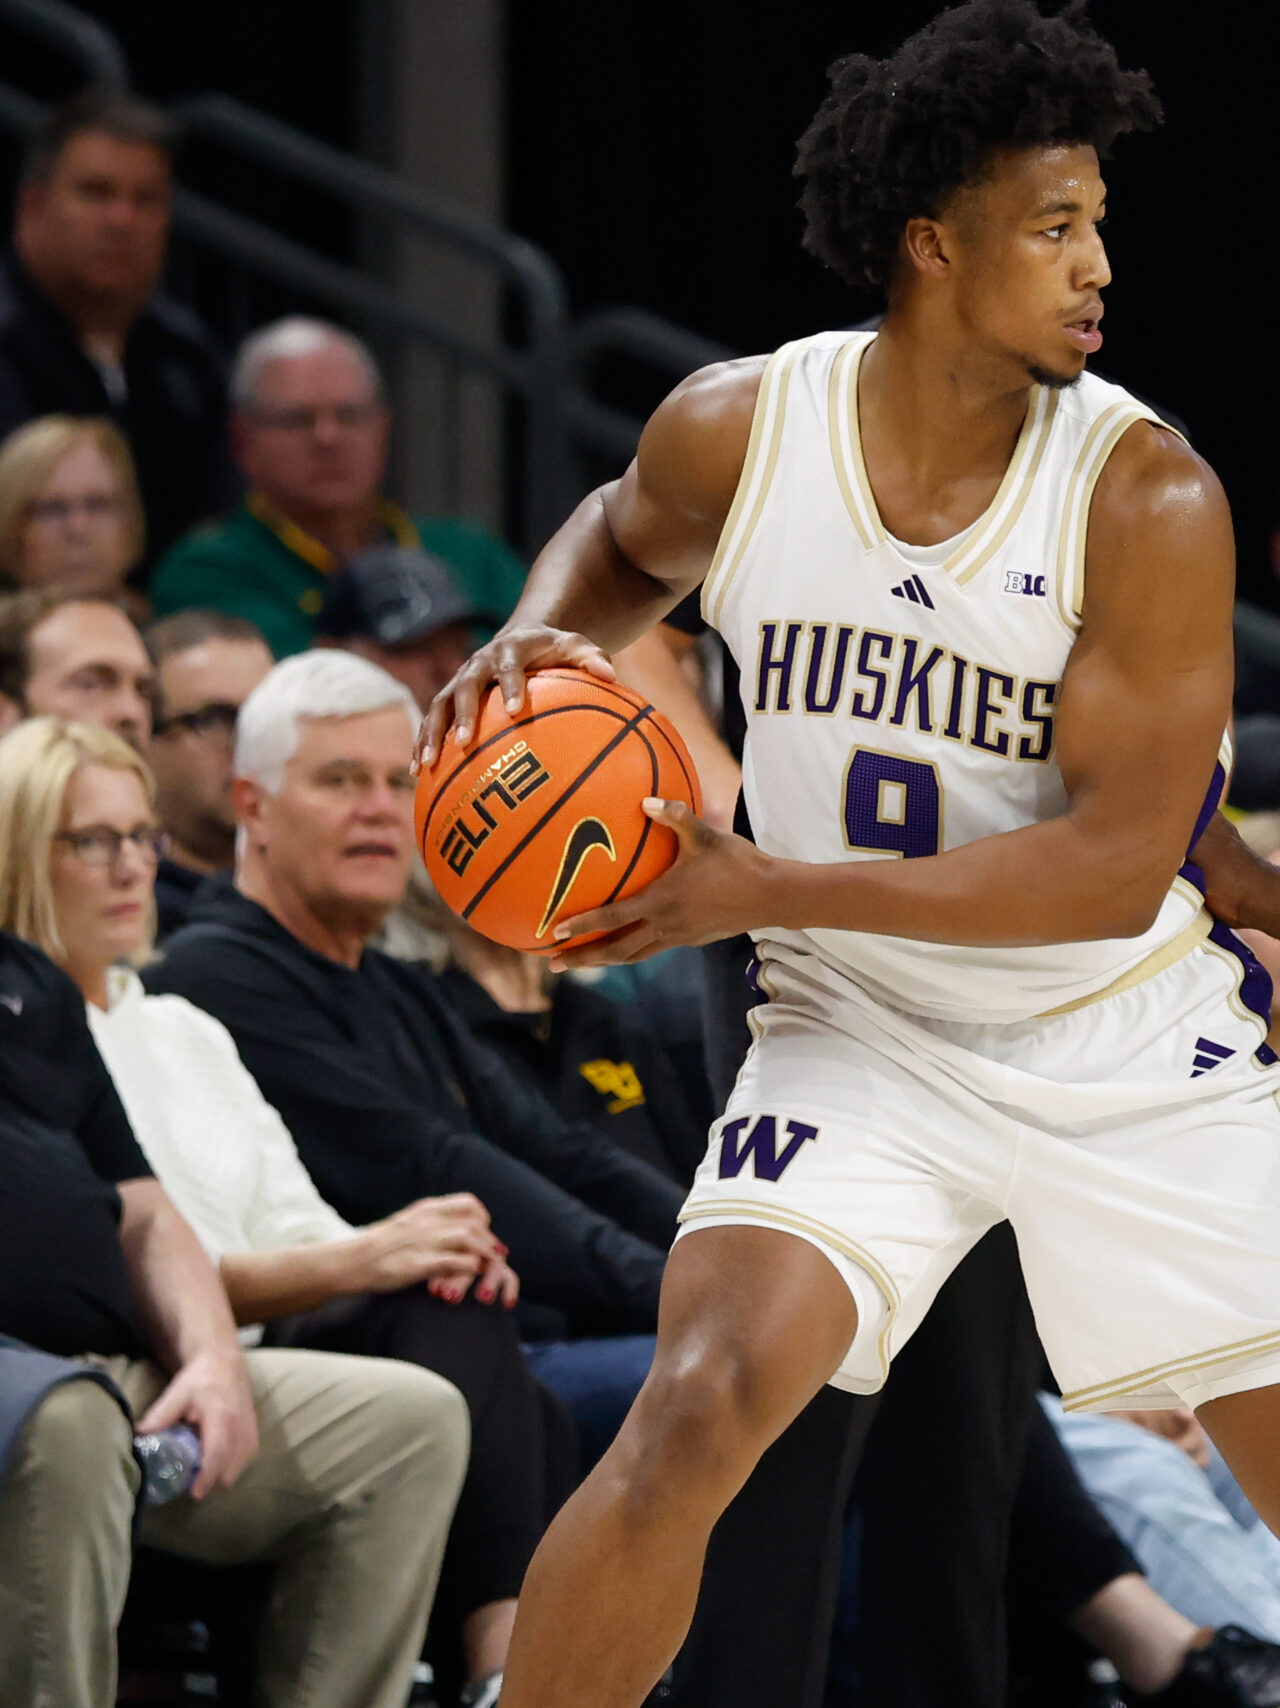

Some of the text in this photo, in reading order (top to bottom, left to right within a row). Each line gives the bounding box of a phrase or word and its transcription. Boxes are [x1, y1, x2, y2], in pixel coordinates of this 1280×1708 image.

[753, 620, 1059, 764] HUSKIES
[440, 748, 550, 878] ELITE
[840, 743, 944, 860] 9
[716, 1113, 823, 1183] W
